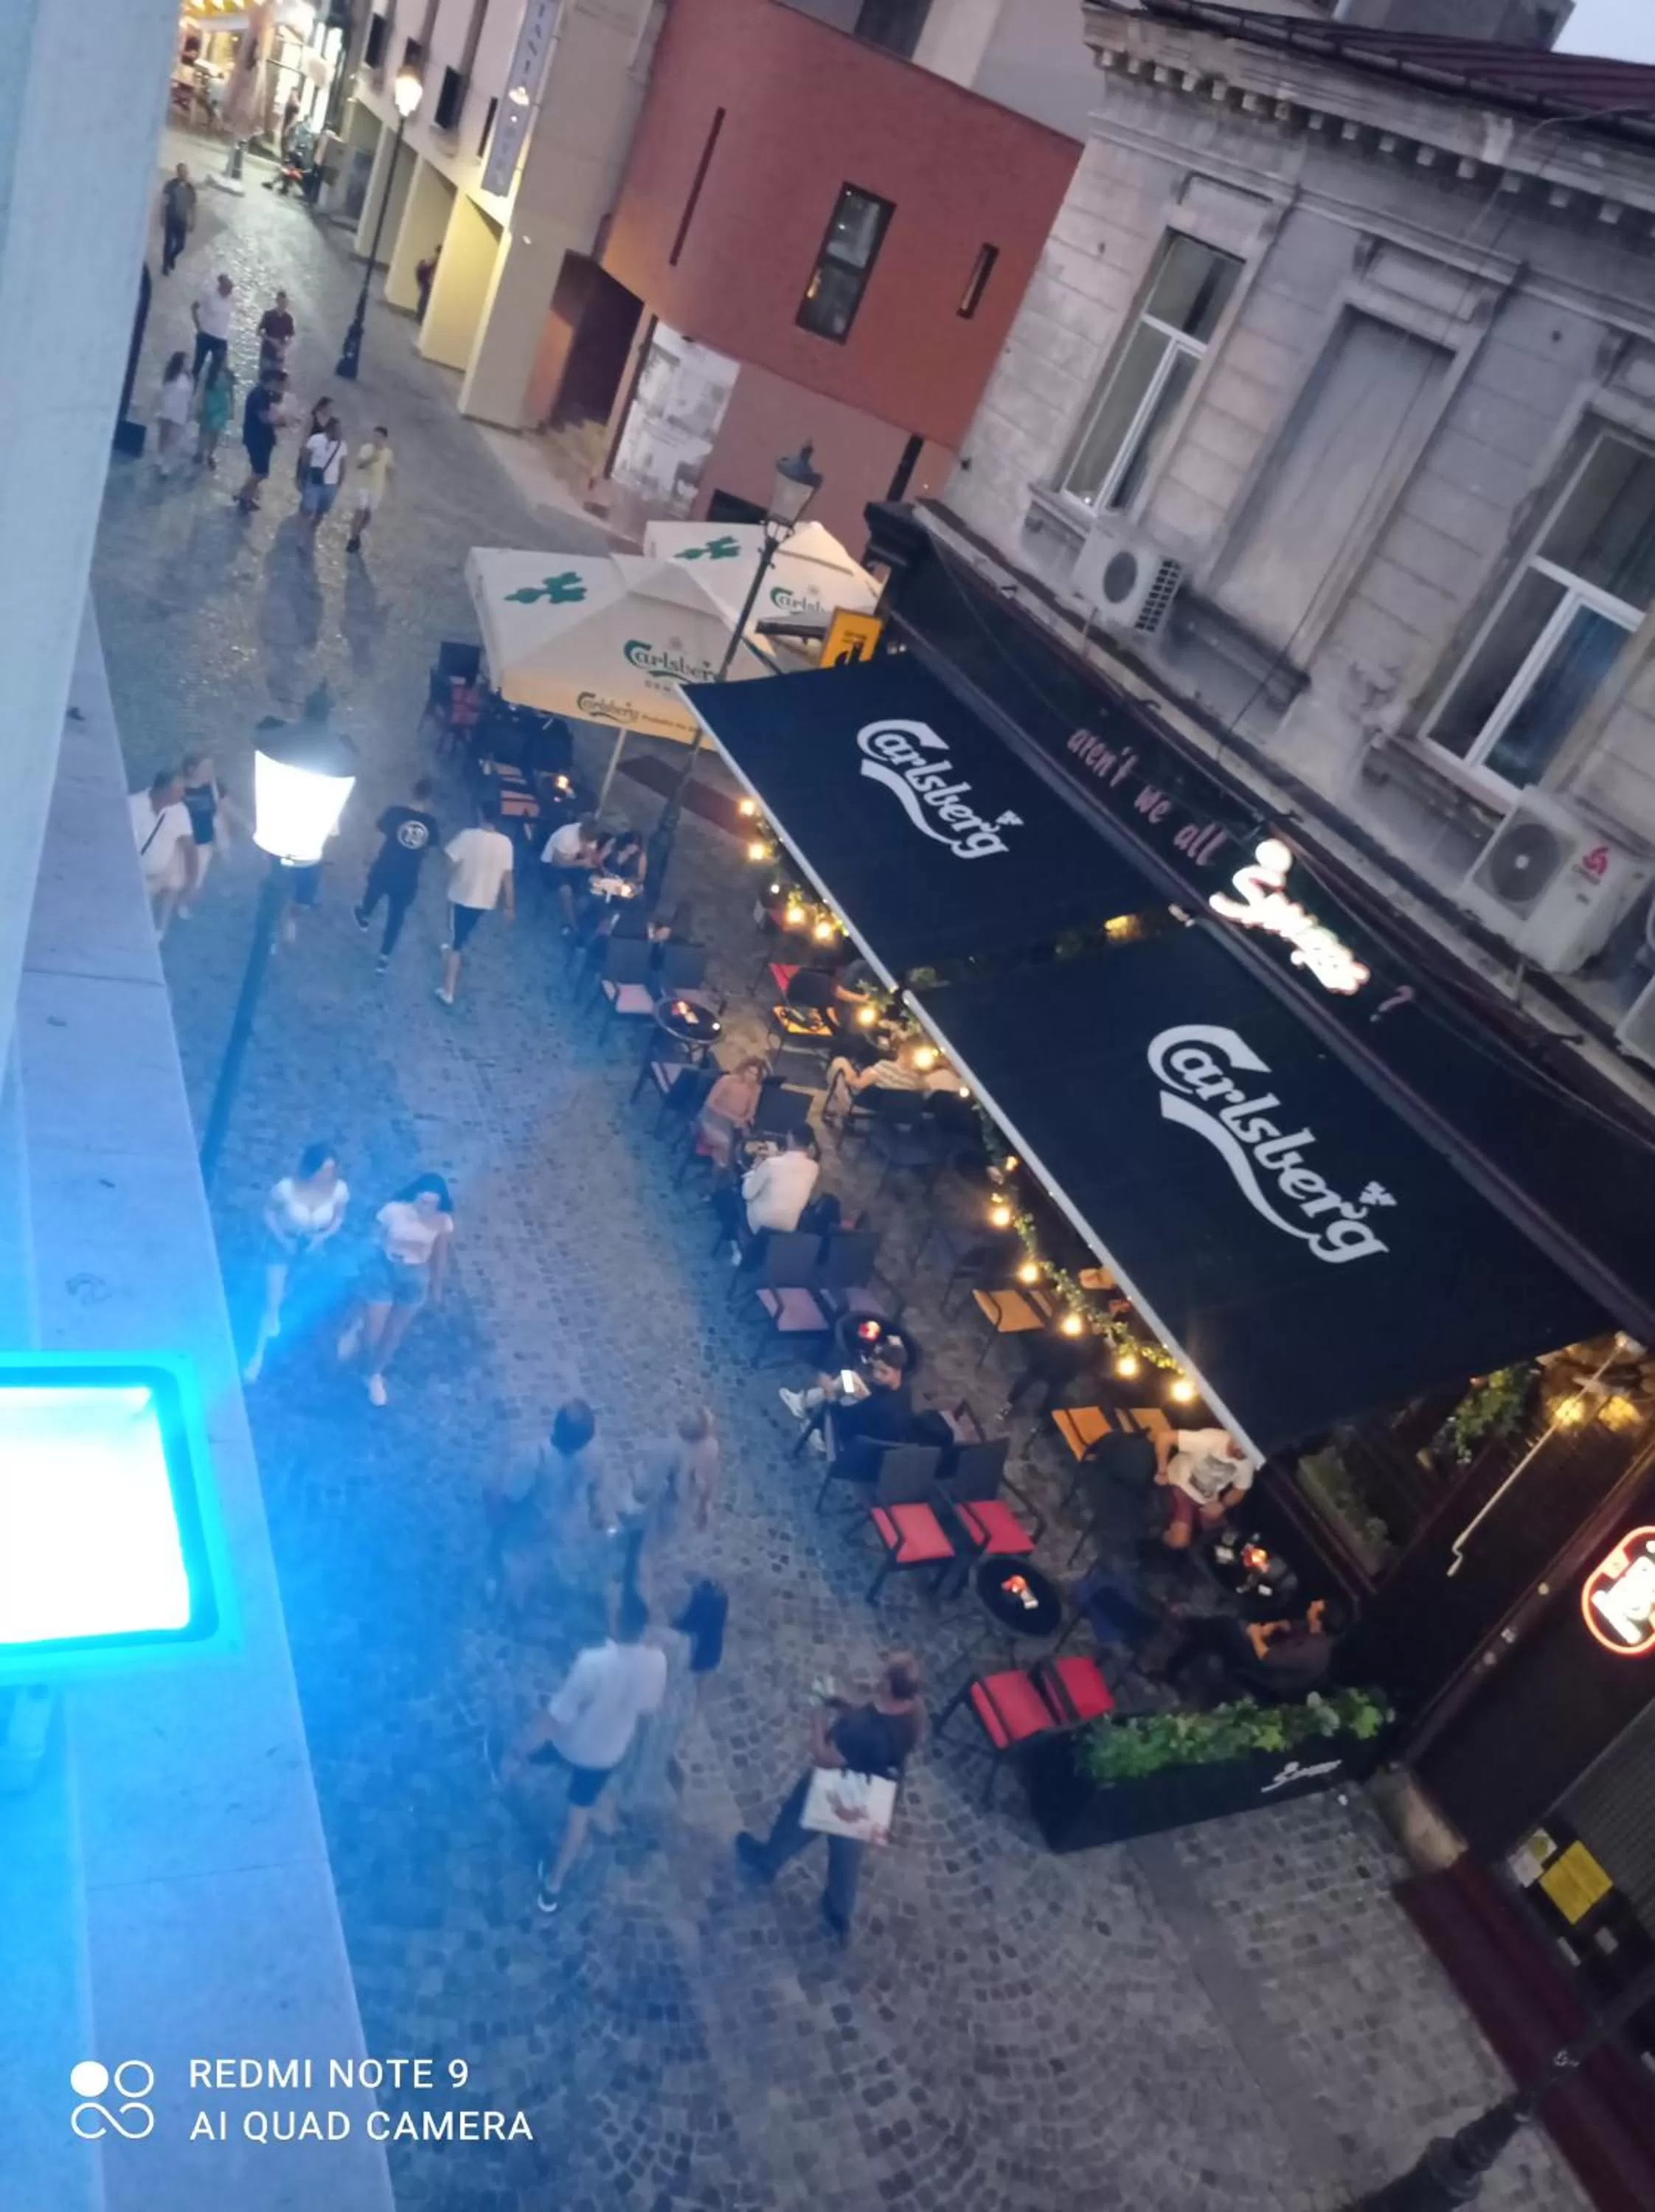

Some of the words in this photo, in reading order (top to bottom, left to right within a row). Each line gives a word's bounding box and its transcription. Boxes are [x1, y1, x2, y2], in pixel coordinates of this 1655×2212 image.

[623, 639, 715, 684] Carlsber
[856, 719, 1024, 859] Carlsberg
[1067, 728, 1139, 787] aren't
[1134, 785, 1171, 824] we
[1173, 823, 1227, 866] all
[1148, 1025, 1397, 1263] Carlsberg
